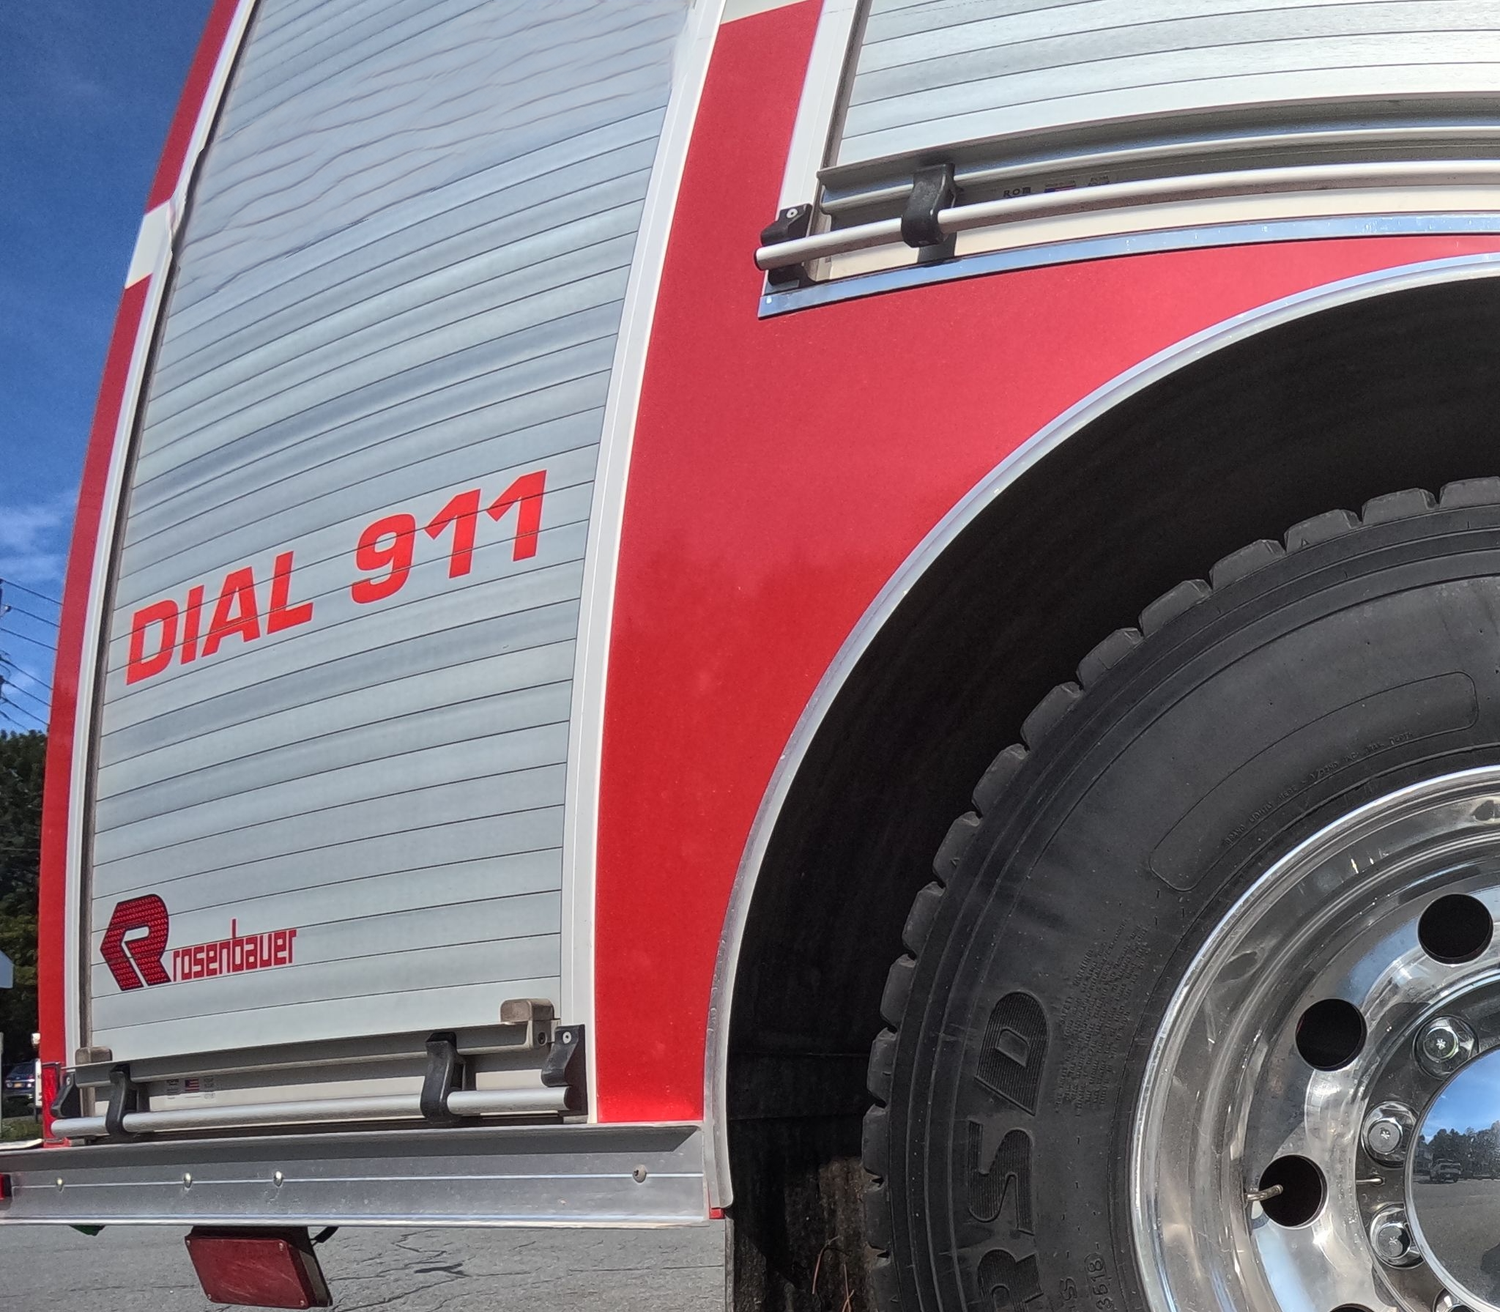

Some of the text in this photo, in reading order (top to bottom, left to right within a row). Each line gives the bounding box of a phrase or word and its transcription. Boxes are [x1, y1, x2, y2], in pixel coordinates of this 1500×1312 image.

[125, 469, 547, 686] DIAL 911
[172, 918, 297, 983] rosenbauer
